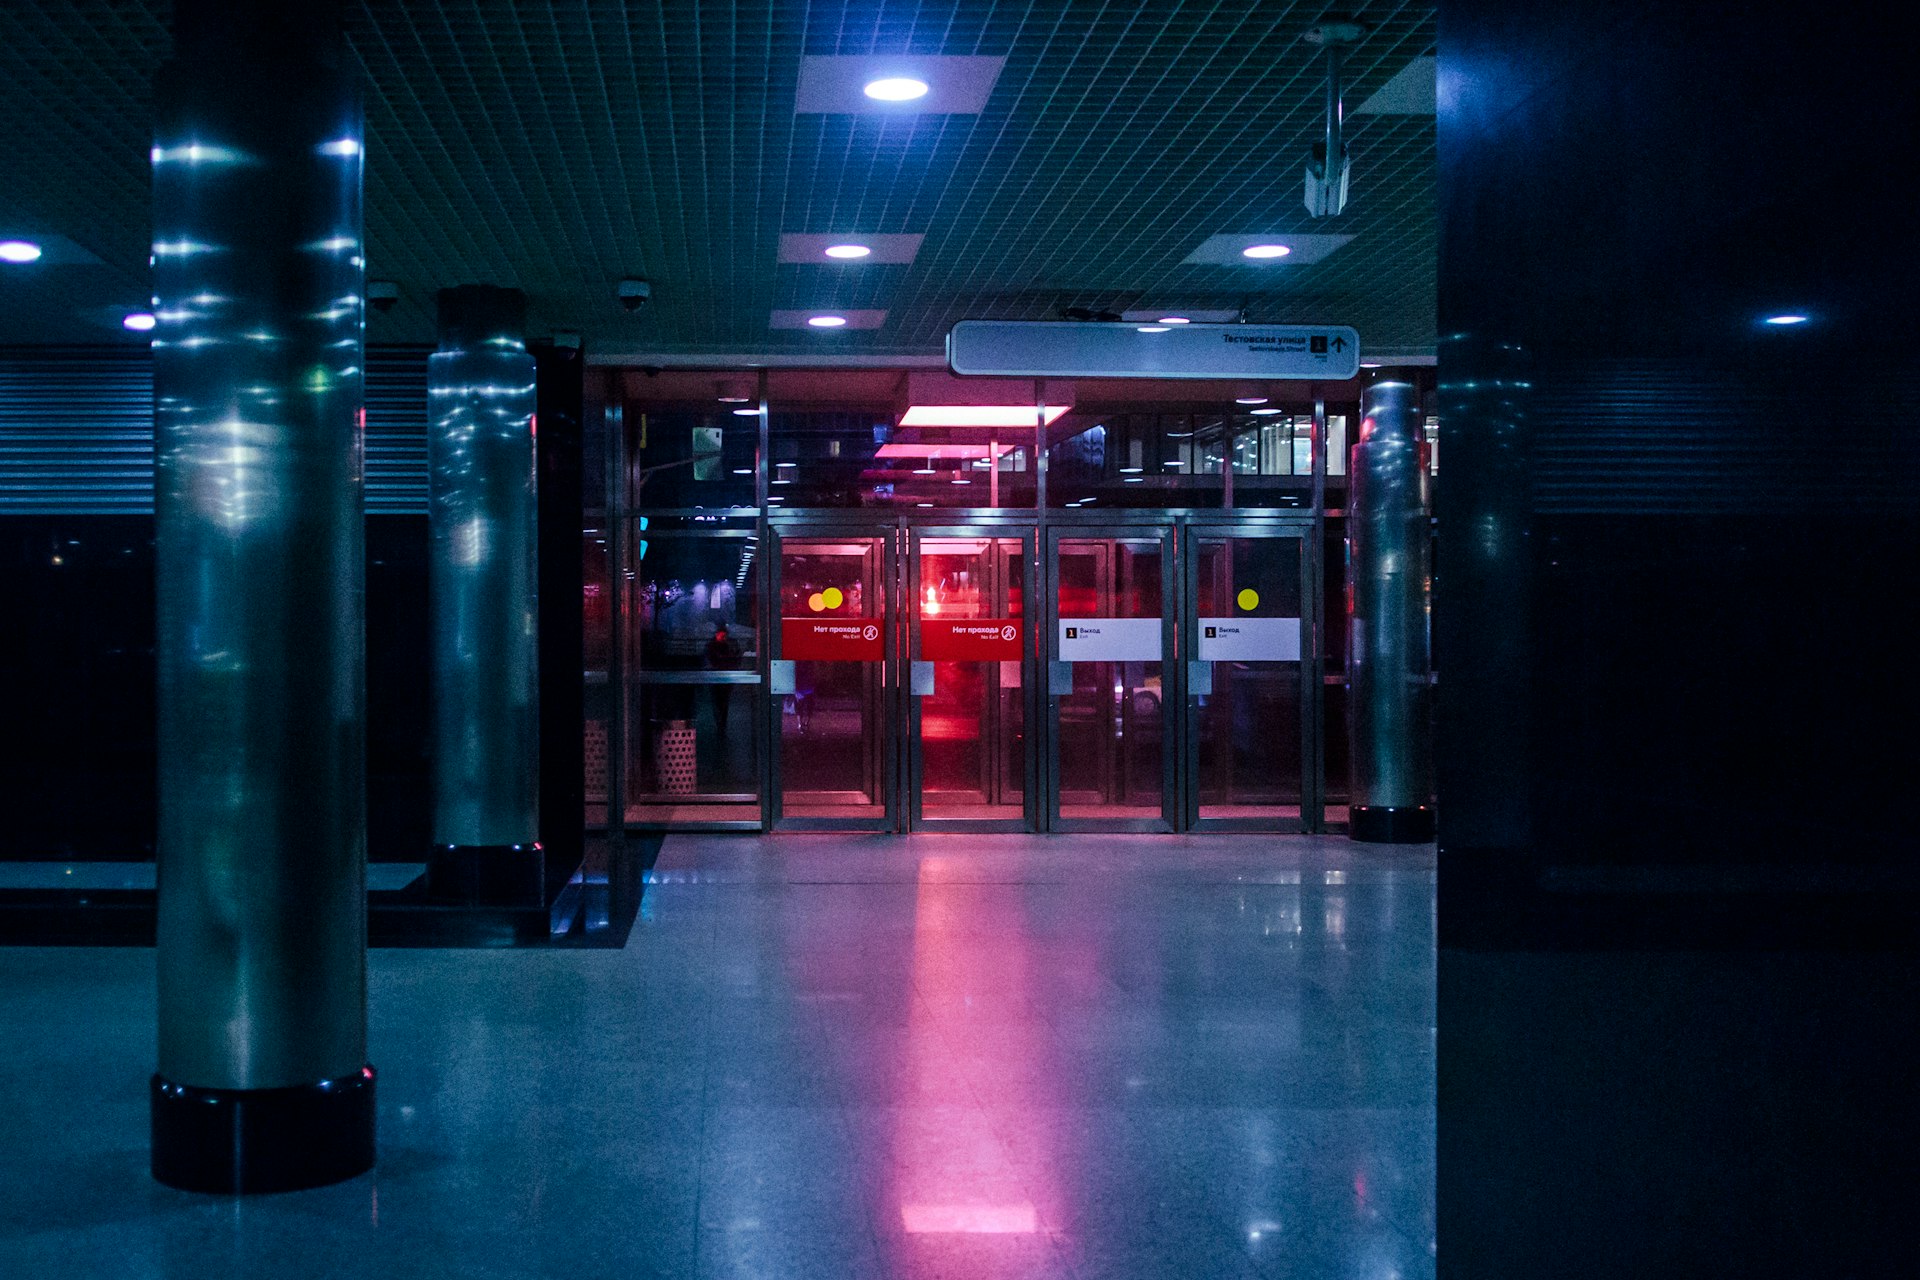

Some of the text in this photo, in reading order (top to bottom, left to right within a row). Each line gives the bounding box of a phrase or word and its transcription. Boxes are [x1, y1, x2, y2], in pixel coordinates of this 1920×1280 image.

[1223, 334, 1306, 345] Тестовская улица
[829, 626, 861, 634] прохода
[968, 626, 999, 634] прохода
